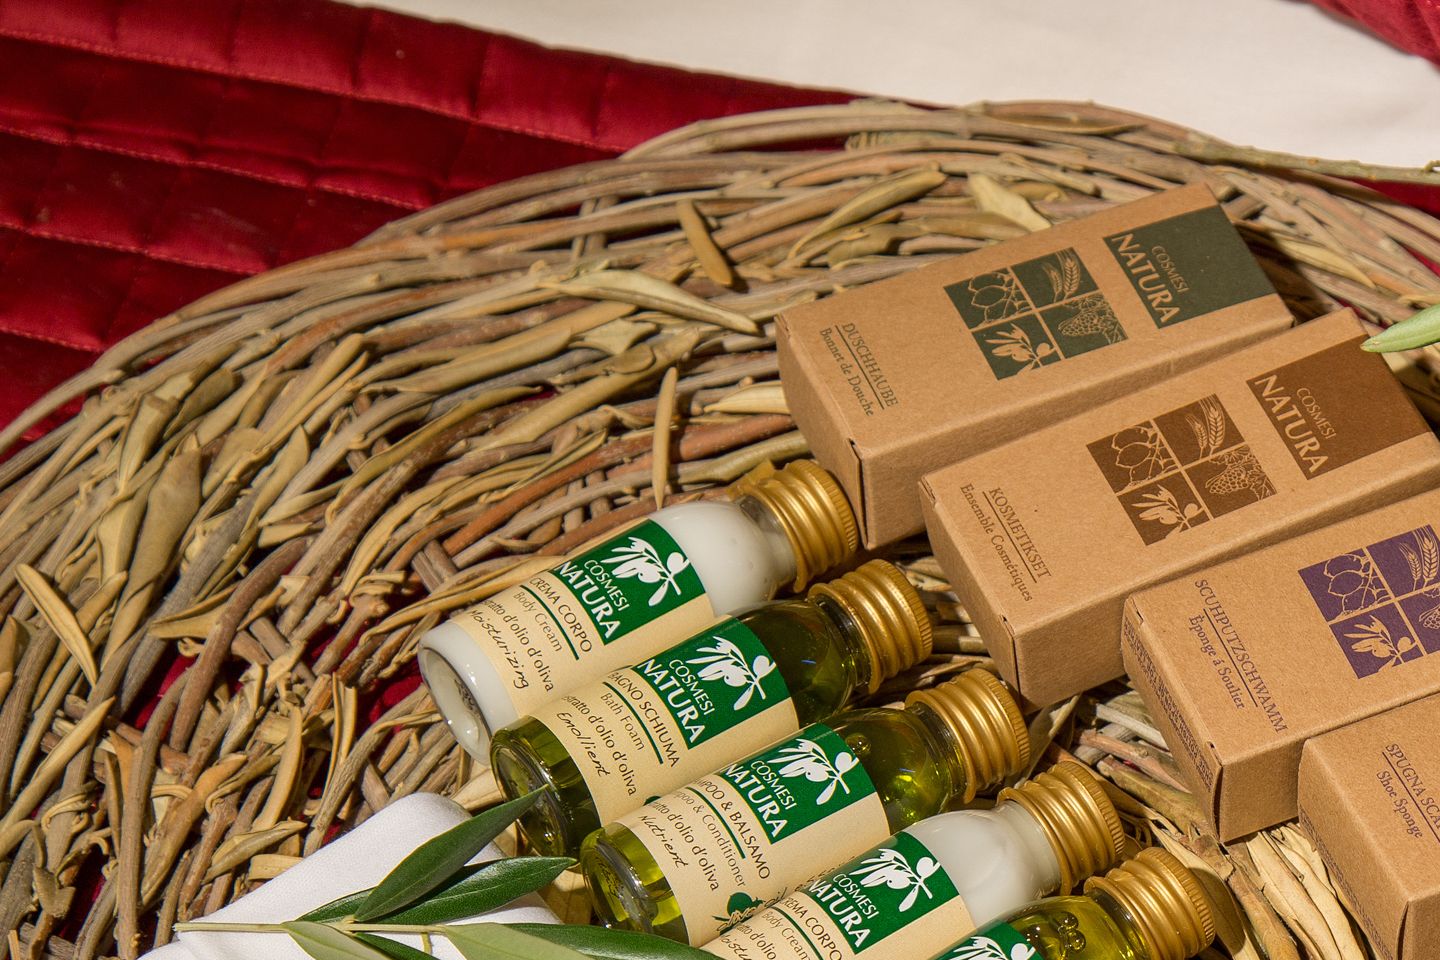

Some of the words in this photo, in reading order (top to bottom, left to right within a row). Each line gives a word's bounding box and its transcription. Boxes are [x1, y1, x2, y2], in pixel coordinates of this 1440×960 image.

[1111, 233, 1180, 323] NATURA
[1152, 246, 1189, 292] COSMESI
[820, 327, 844, 362] Bonnet
[840, 363, 853, 375] de
[847, 375, 874, 416] Douche
[842, 323, 898, 406] DUSCHHAUBE
[1254, 374, 1329, 473] NATURA
[1296, 387, 1337, 439] COSMESI
[960, 483, 995, 534] Ensemble
[991, 534, 1033, 602] Cosmétiques
[988, 487, 1051, 578] KOSMETIKSET
[513, 592, 537, 612] Body
[534, 612, 563, 652] Cream
[529, 577, 561, 605] CREMA
[558, 604, 592, 652] CORPO
[554, 560, 621, 638] NATURA
[584, 559, 630, 611] COSMESI
[470, 610, 529, 689] Moisturizing
[503, 615, 530, 647] d'olio
[527, 648, 554, 692] d'oliva
[669, 659, 715, 715] COSMESI
[1194, 579, 1288, 733] SCUHPUTZSCHWAMM
[600, 693, 623, 715] Bath
[620, 715, 645, 751] Foam
[608, 672, 644, 701] BAGNO
[639, 701, 680, 767] SCHIUMA
[637, 659, 705, 743] NATURA
[1217, 667, 1245, 709] Soulier
[557, 712, 611, 776] Emollient
[588, 715, 616, 749] d'olio
[612, 751, 637, 796] d'oliva
[1385, 743, 1426, 797] SPUGNA
[721, 763, 788, 838] NATURA
[750, 760, 797, 810] COSMESI
[1376, 770, 1398, 798] Shoe
[1393, 798, 1423, 838] Sponge
[639, 815, 689, 868] Nutrient
[667, 814, 695, 844] d'olio
[691, 845, 720, 891] d'oliva
[693, 805, 704, 814] &
[702, 814, 746, 887] Conditioner
[721, 801, 733, 811] &
[729, 811, 771, 879] BALSAMO
[761, 911, 784, 930] Body
[781, 897, 809, 918] REMA
[808, 879, 871, 948] NATURA
[833, 873, 880, 919] COSMESI
[750, 933, 776, 960] d'olio
